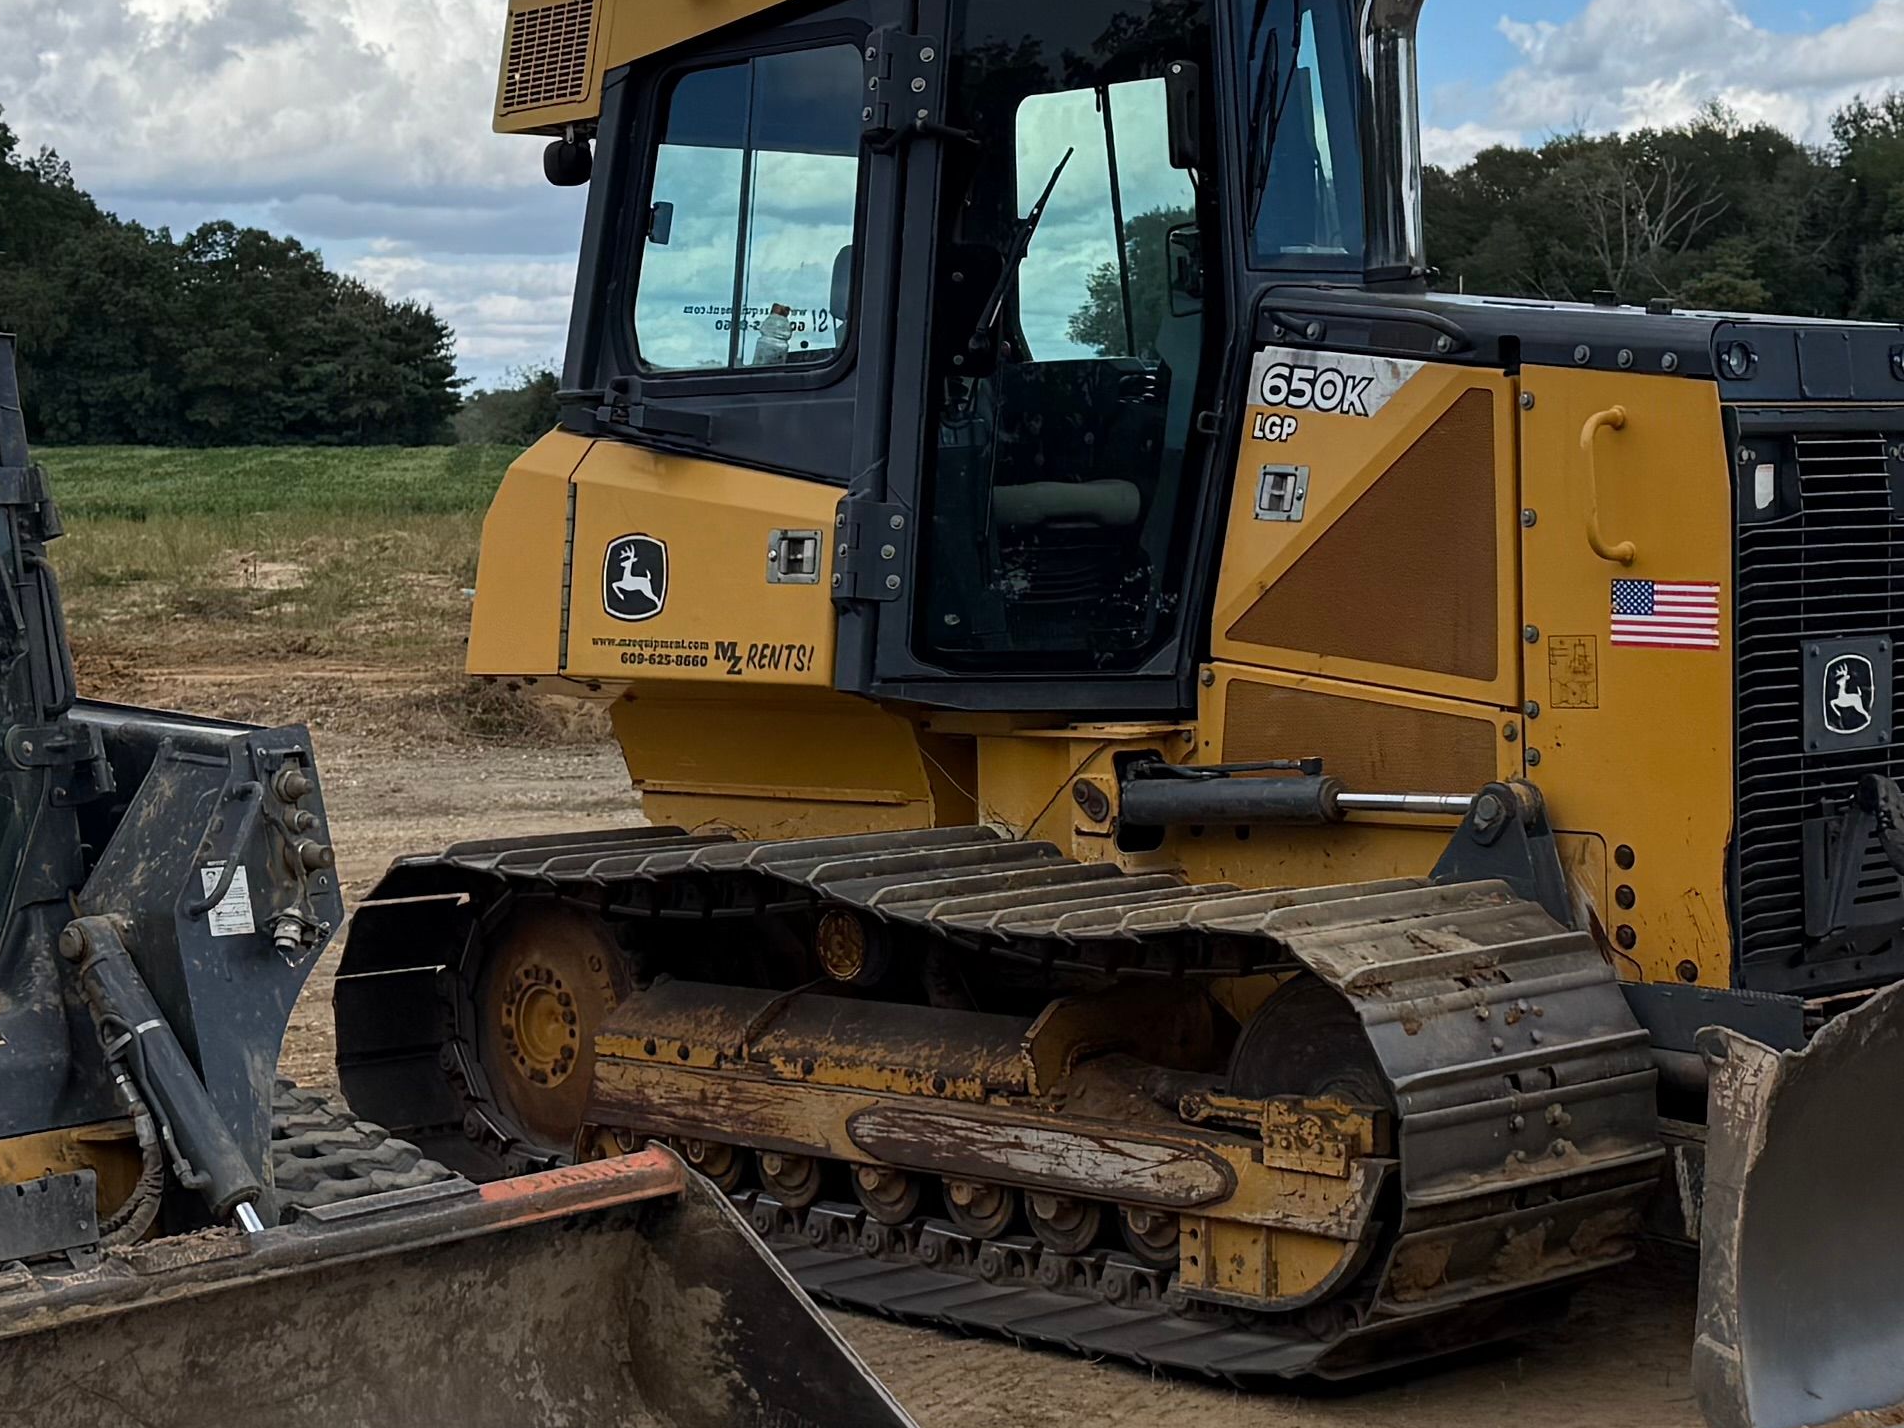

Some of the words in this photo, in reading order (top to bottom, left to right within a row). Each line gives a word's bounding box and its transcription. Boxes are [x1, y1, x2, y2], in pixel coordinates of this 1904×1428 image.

[1261, 362, 1375, 418] 650K
[1252, 412, 1297, 442] LGP
[620, 652, 708, 667] 609-625-8660
[746, 643, 815, 672] RENTS!
